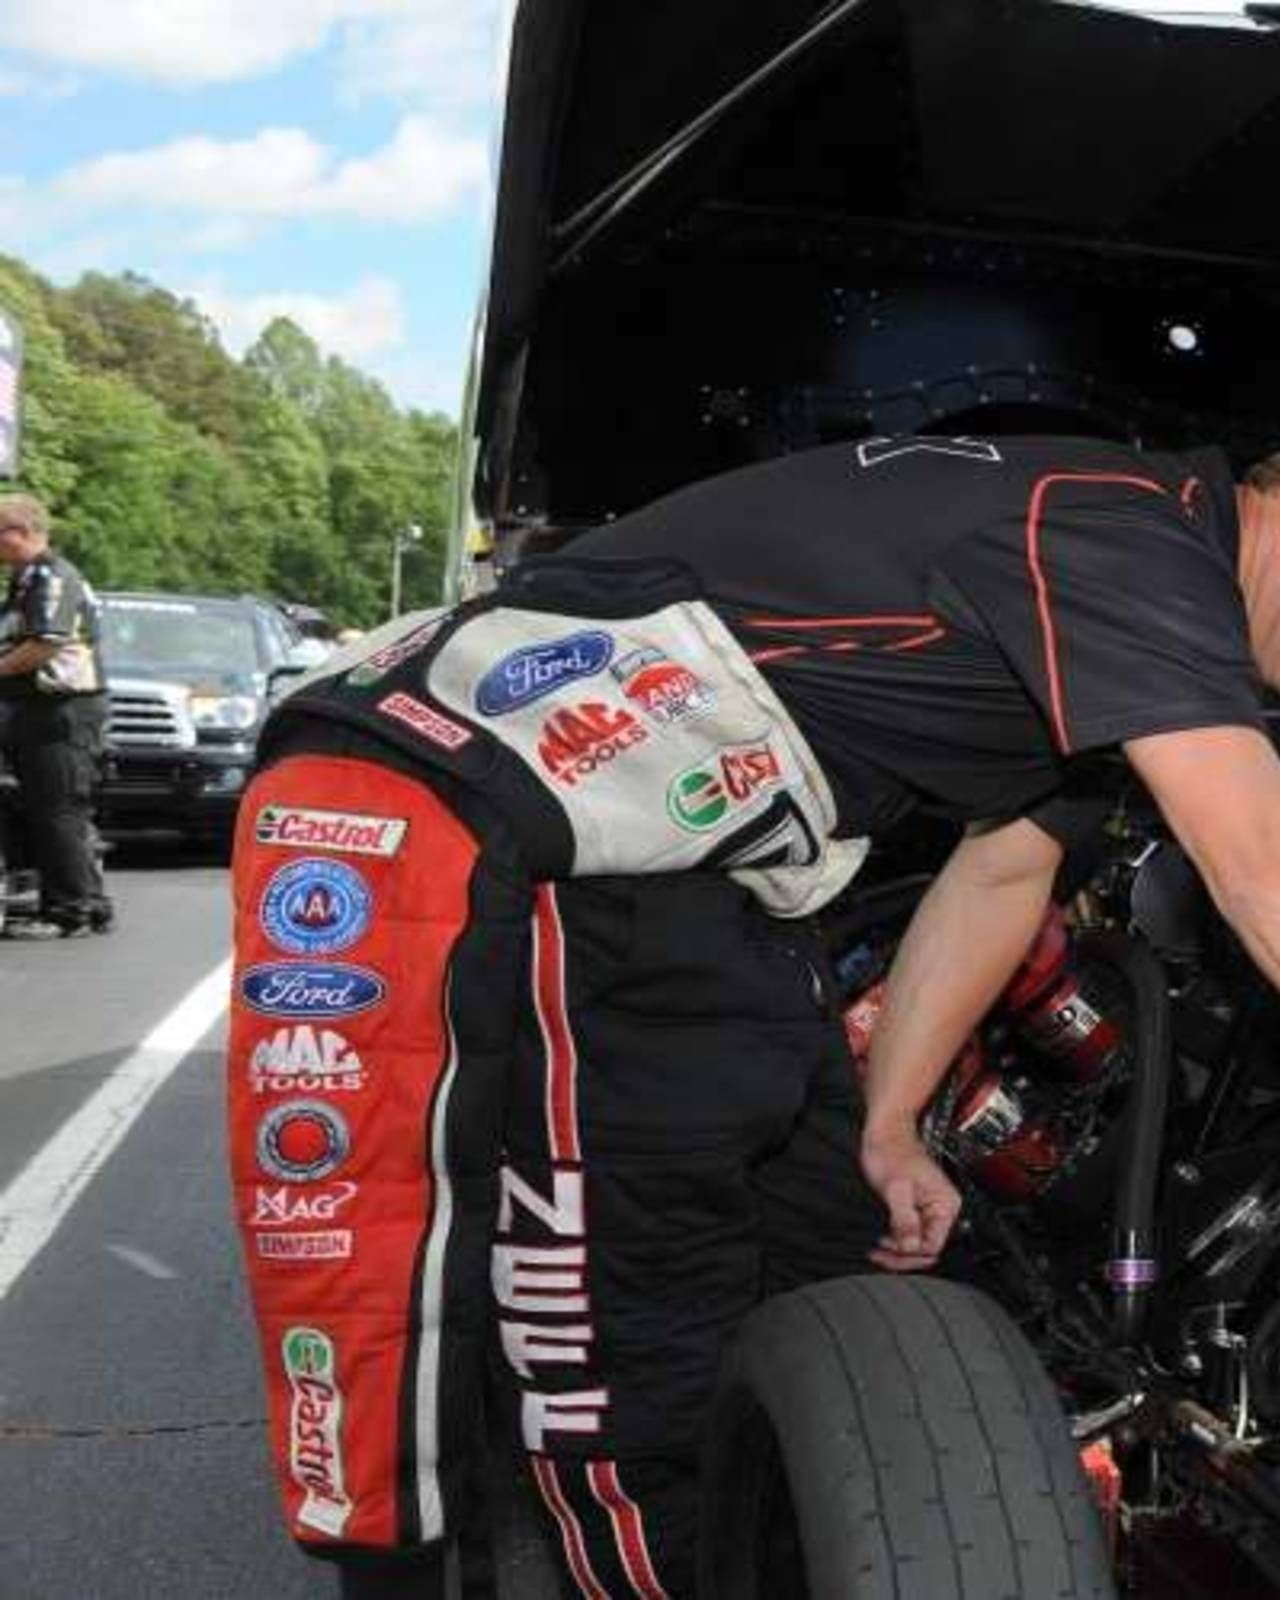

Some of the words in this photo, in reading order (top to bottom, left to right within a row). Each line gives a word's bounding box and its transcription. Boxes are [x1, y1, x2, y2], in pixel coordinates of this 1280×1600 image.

[505, 649, 591, 698] Ford
[538, 702, 636, 774] MAC
[559, 724, 648, 787] TOOLS
[277, 814, 388, 849] Castrol
[259, 969, 351, 1006] Ford
[253, 1025, 362, 1074] MAC
[253, 1073, 362, 1092] TOOLS
[490, 1165, 609, 1452] NEFF
[296, 1376, 347, 1504] Castrol
